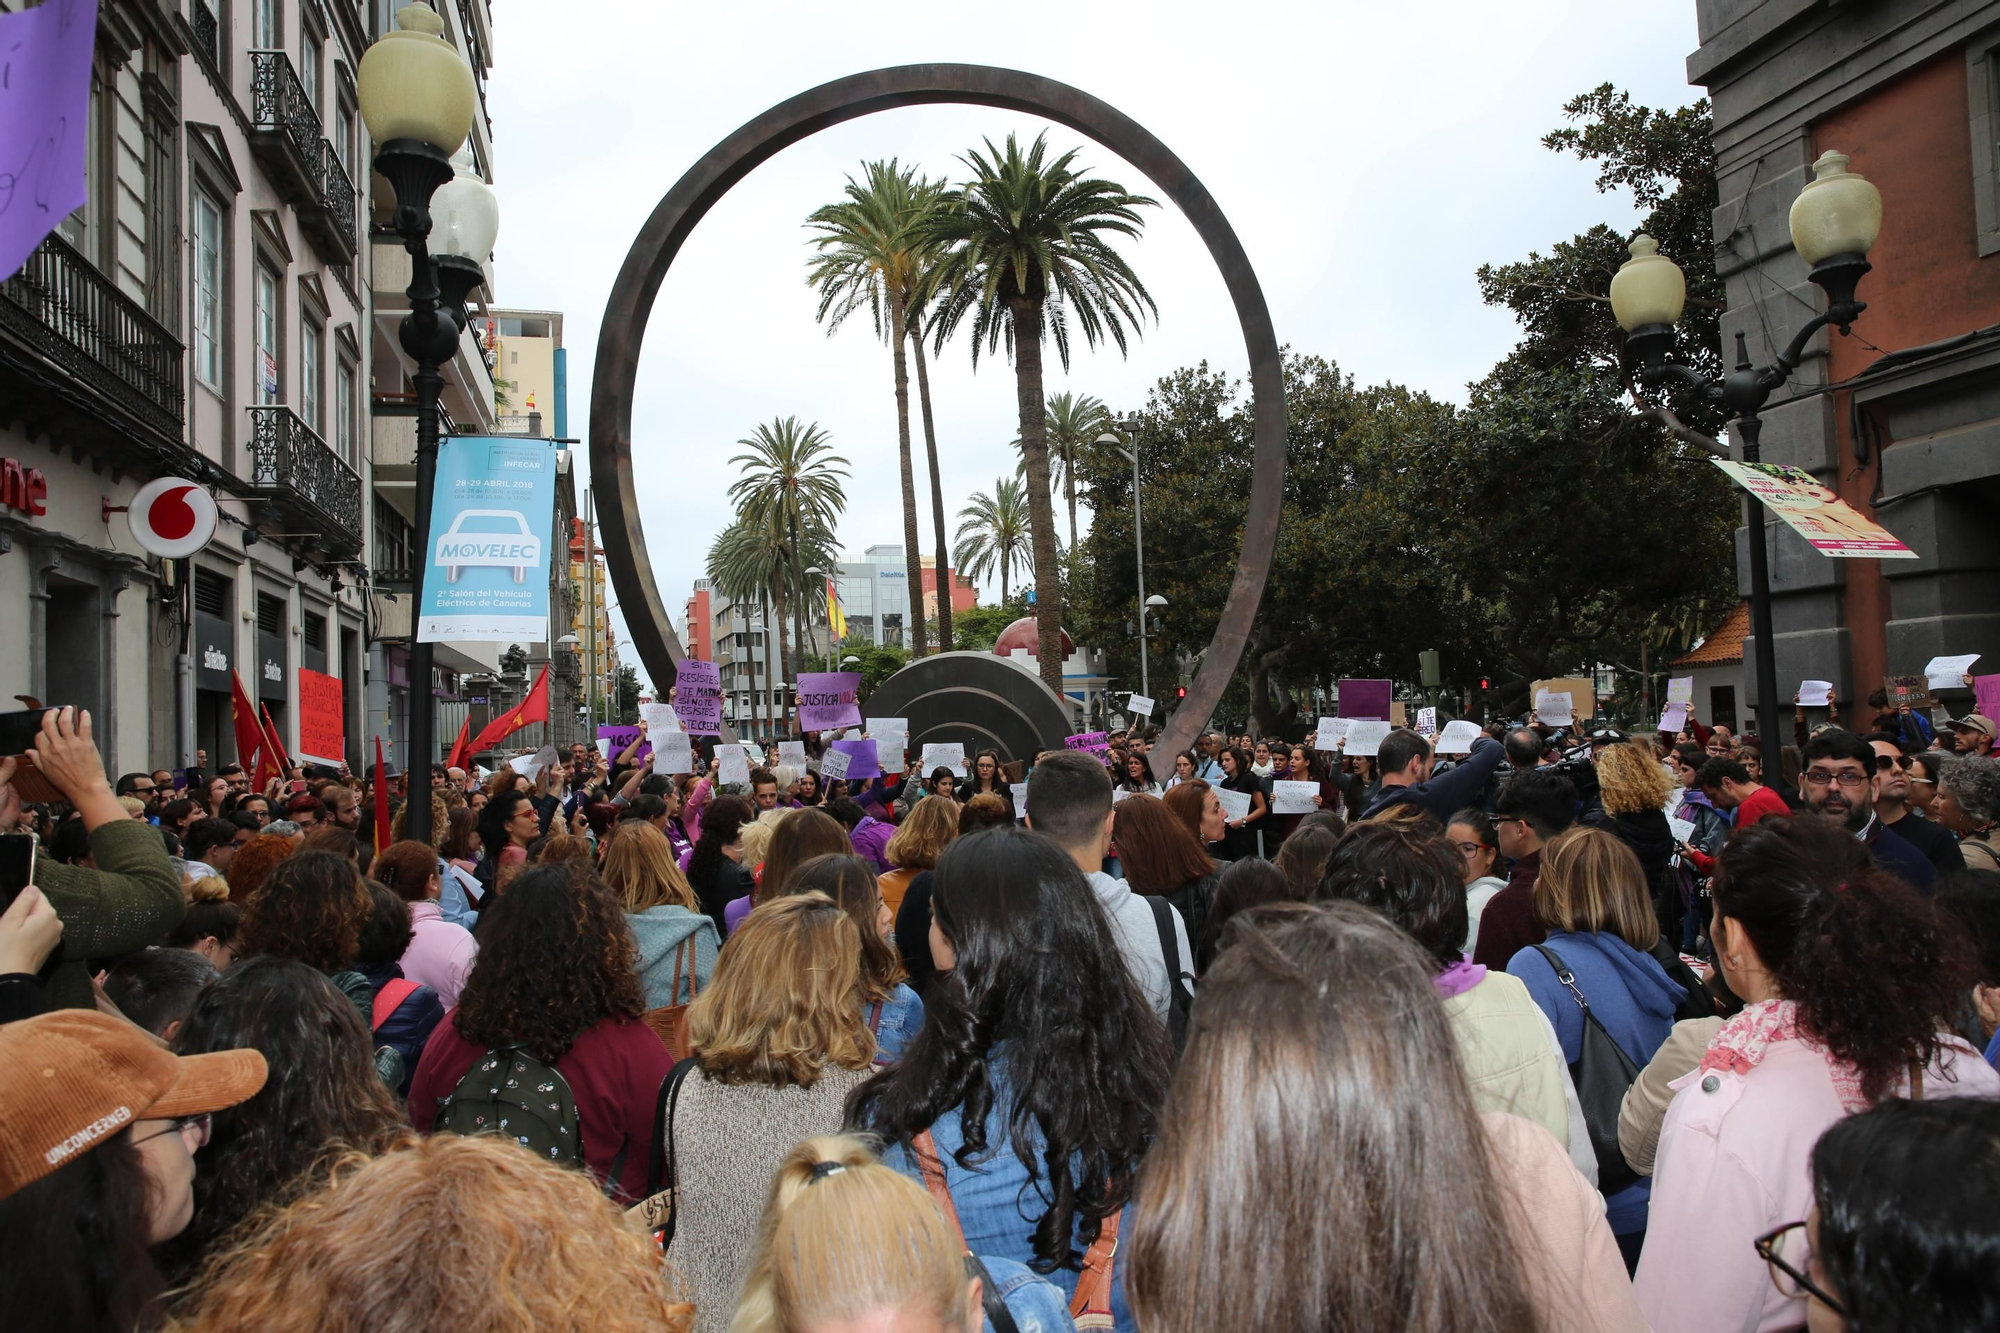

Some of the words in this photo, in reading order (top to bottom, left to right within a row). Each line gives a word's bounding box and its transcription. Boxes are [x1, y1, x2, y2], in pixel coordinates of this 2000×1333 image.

[504, 461, 541, 469] INFECAR
[513, 481, 534, 489] 2018
[441, 543, 536, 559] MOVELEC
[449, 589, 474, 598] Salón
[476, 589, 491, 598] del
[494, 589, 533, 598] Vehículo
[436, 598, 477, 608] Eléctrico
[478, 599, 491, 608] de
[493, 599, 533, 608] Canarias
[678, 672, 719, 685] RESISTES
[300, 682, 311, 694] LA
[311, 682, 342, 702] JUSTICIA
[682, 686, 694, 697] TE
[300, 693, 342, 719] PATRIARCAL
[691, 698, 703, 707] NO
[704, 699, 713, 707] TE
[674, 704, 716, 717] RESISTES
[1422, 708, 1433, 717] YO
[307, 715, 325, 728] NOS
[697, 720, 721, 732] CREEN
[1426, 716, 1435, 725] TE
[1418, 725, 1436, 735] CREO
[300, 727, 343, 747] CONDENADO
[311, 741, 341, 758] TODAS
[1281, 799, 1291, 807] TE
[1294, 799, 1315, 807] CREO
[44, 1105, 132, 1165] UNCONCERNED
